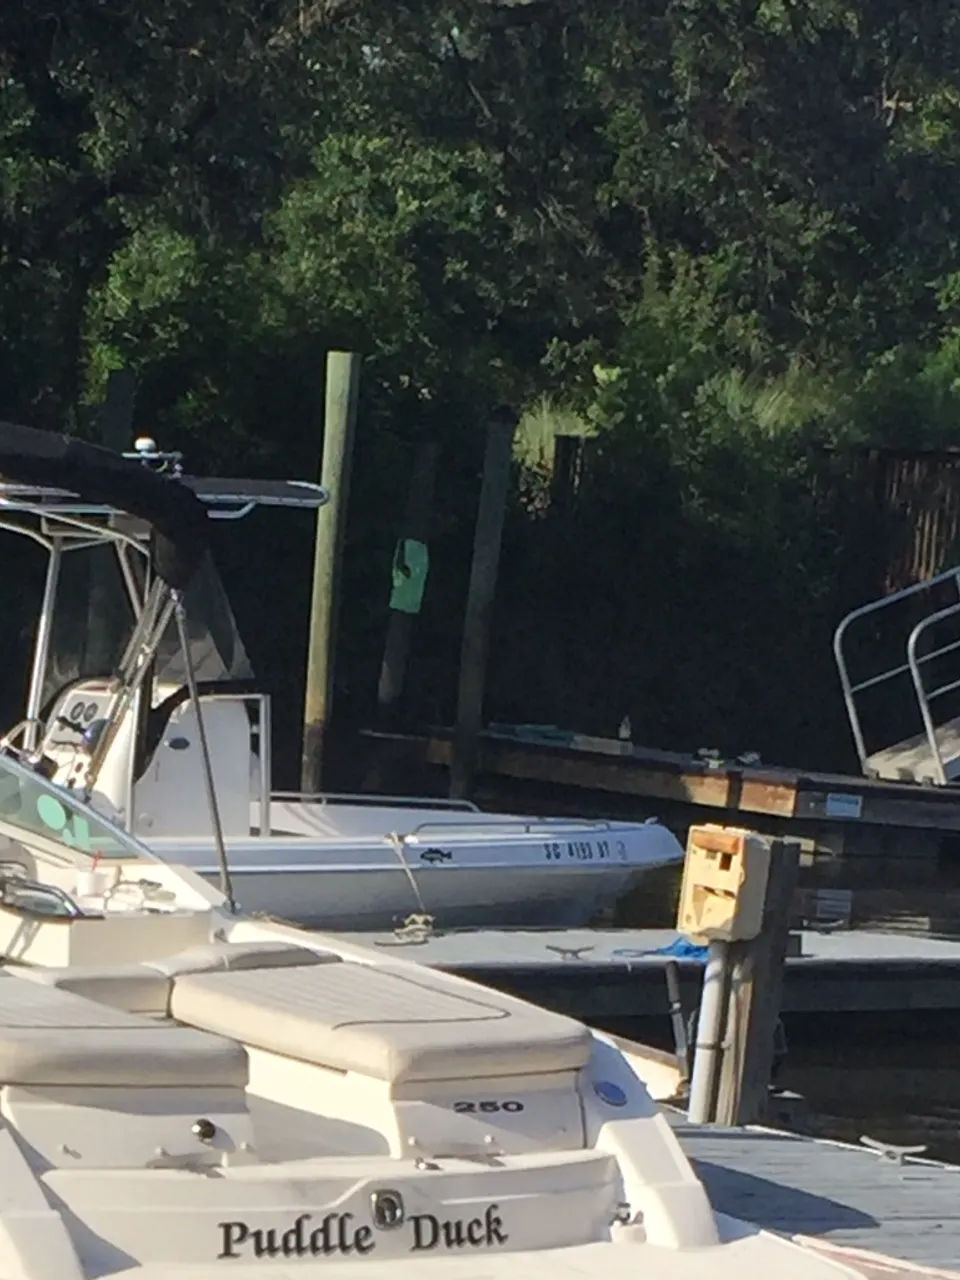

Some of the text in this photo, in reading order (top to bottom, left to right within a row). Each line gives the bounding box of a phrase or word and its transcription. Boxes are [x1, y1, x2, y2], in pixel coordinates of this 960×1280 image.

[453, 1101, 524, 1113] 250
[218, 1204, 509, 1258] Puddle Duck
